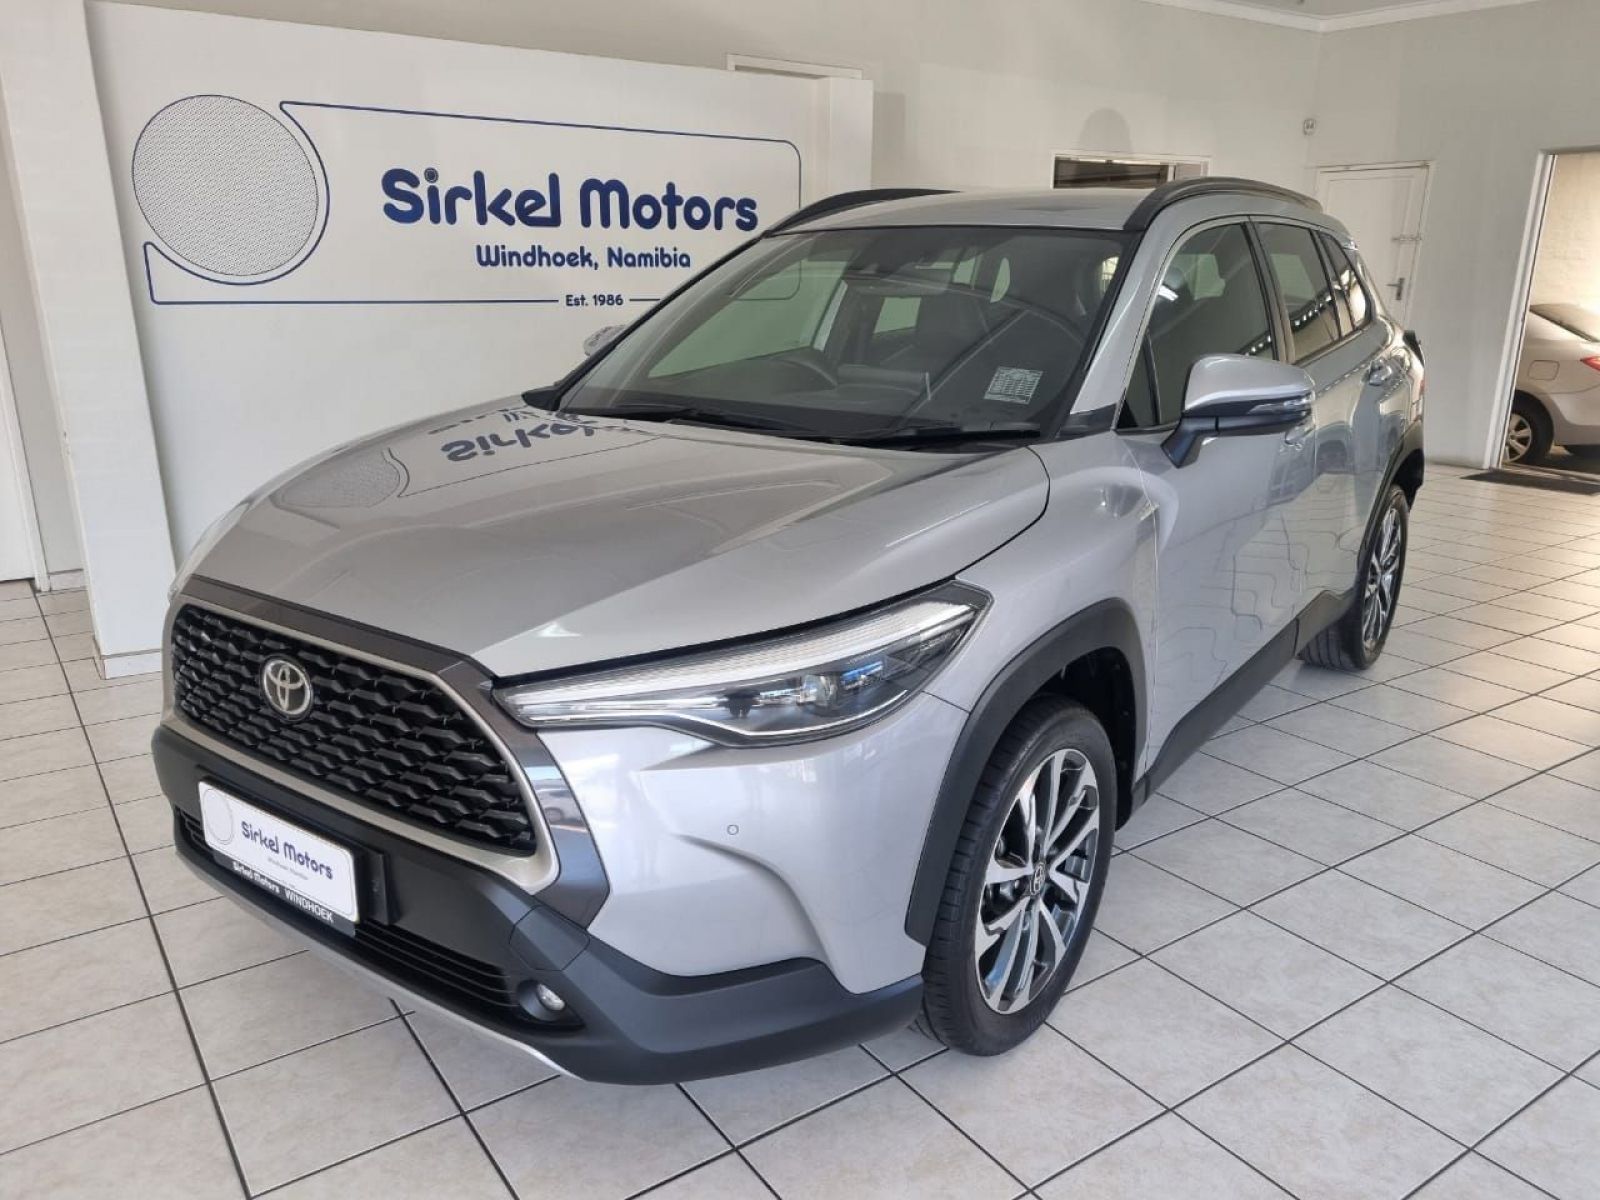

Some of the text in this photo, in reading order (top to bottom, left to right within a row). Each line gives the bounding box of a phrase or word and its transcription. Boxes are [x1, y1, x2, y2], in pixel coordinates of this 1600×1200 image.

[381, 168, 759, 231] Sirkel Motors
[475, 245, 691, 270] Windhoek, Namibia
[565, 294, 624, 307] Est. 1986
[241, 820, 280, 854] Sirkel
[283, 841, 333, 880] Motors
[284, 887, 335, 924] WINDHOEK
